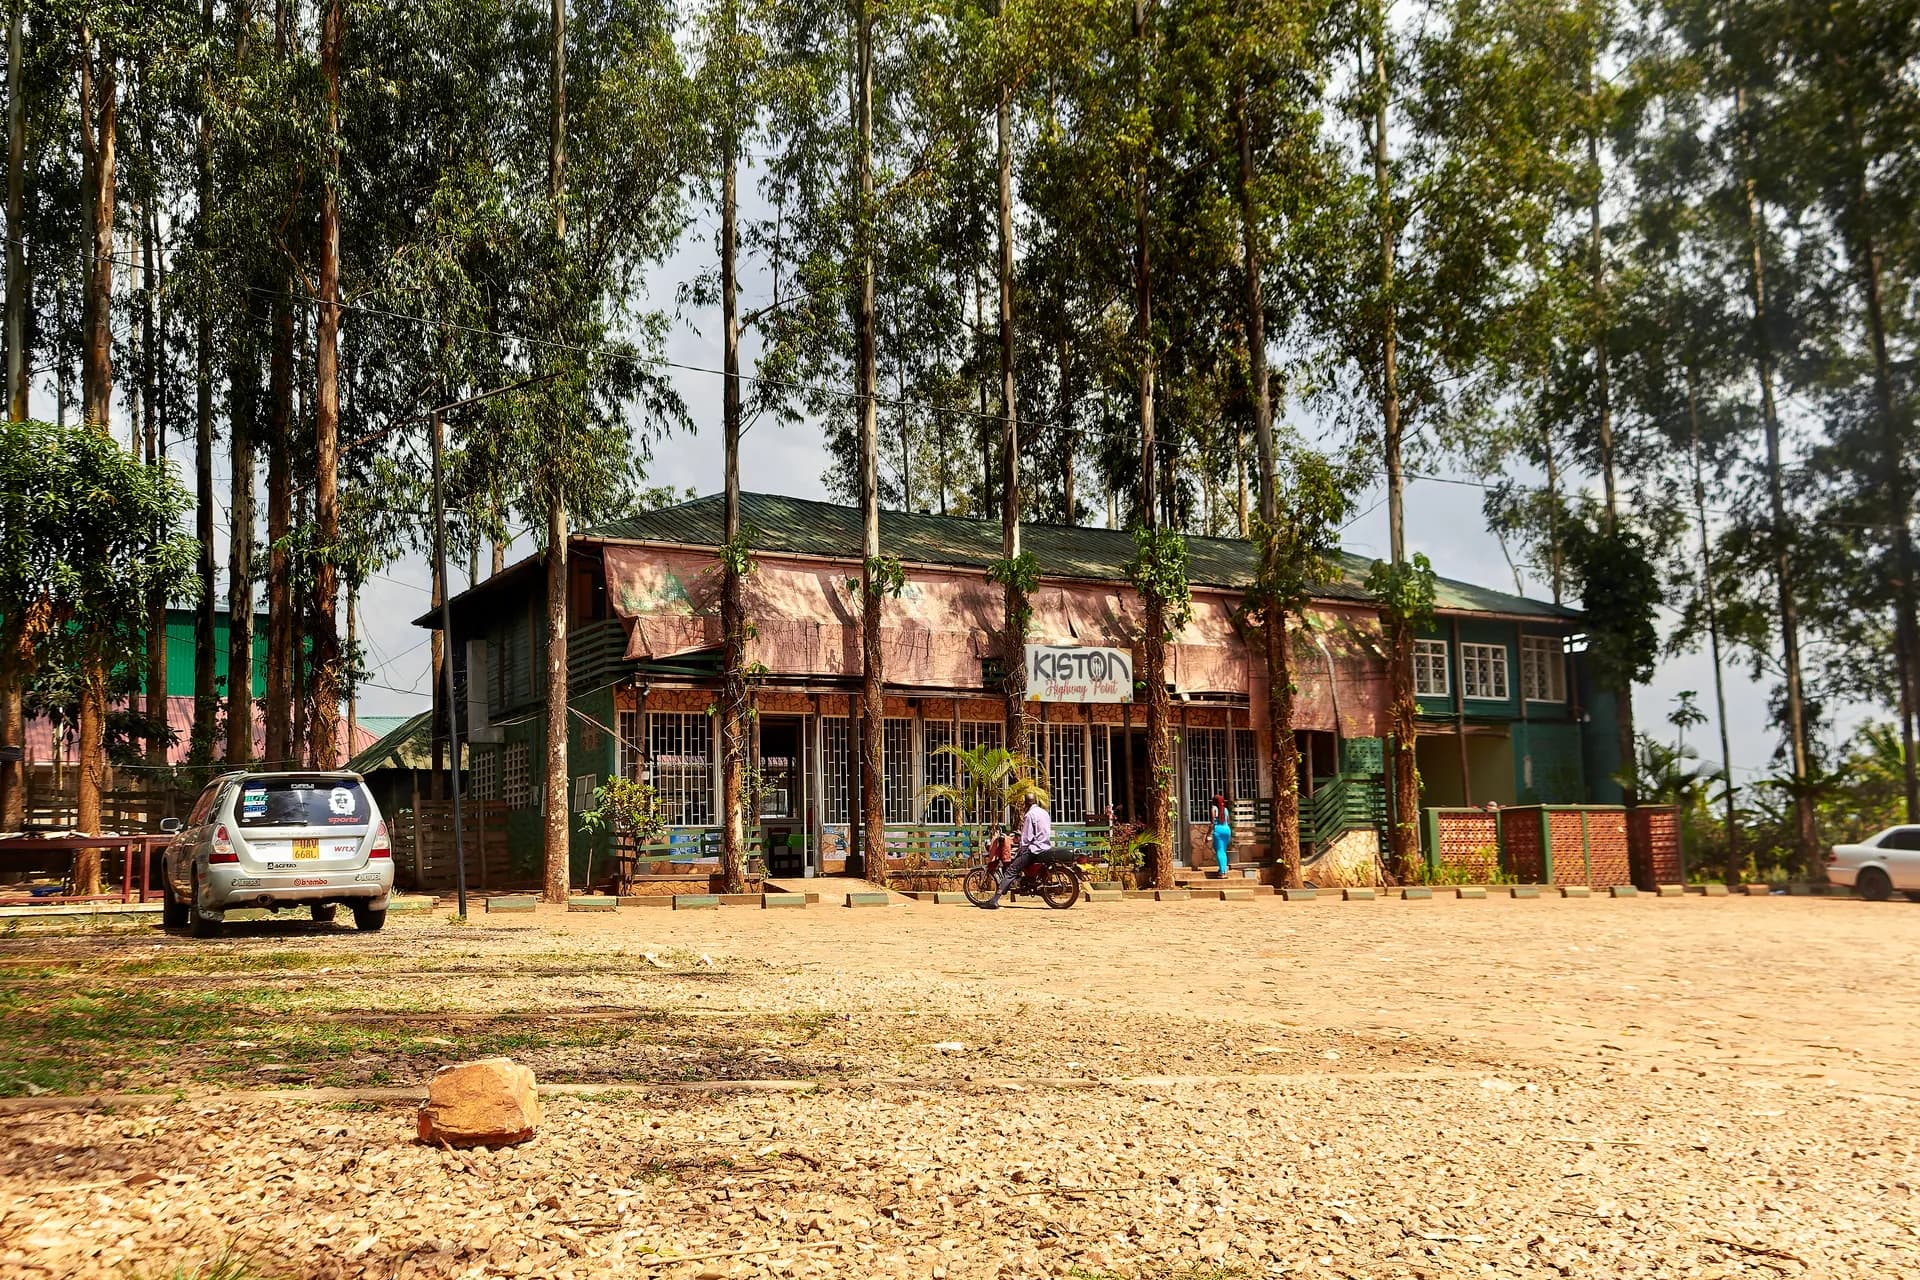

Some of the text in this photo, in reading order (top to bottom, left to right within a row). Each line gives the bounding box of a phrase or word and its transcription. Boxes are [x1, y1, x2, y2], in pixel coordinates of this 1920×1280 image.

[1034, 650, 1130, 682] KISTON
[1045, 676, 1118, 700] Highway Point
